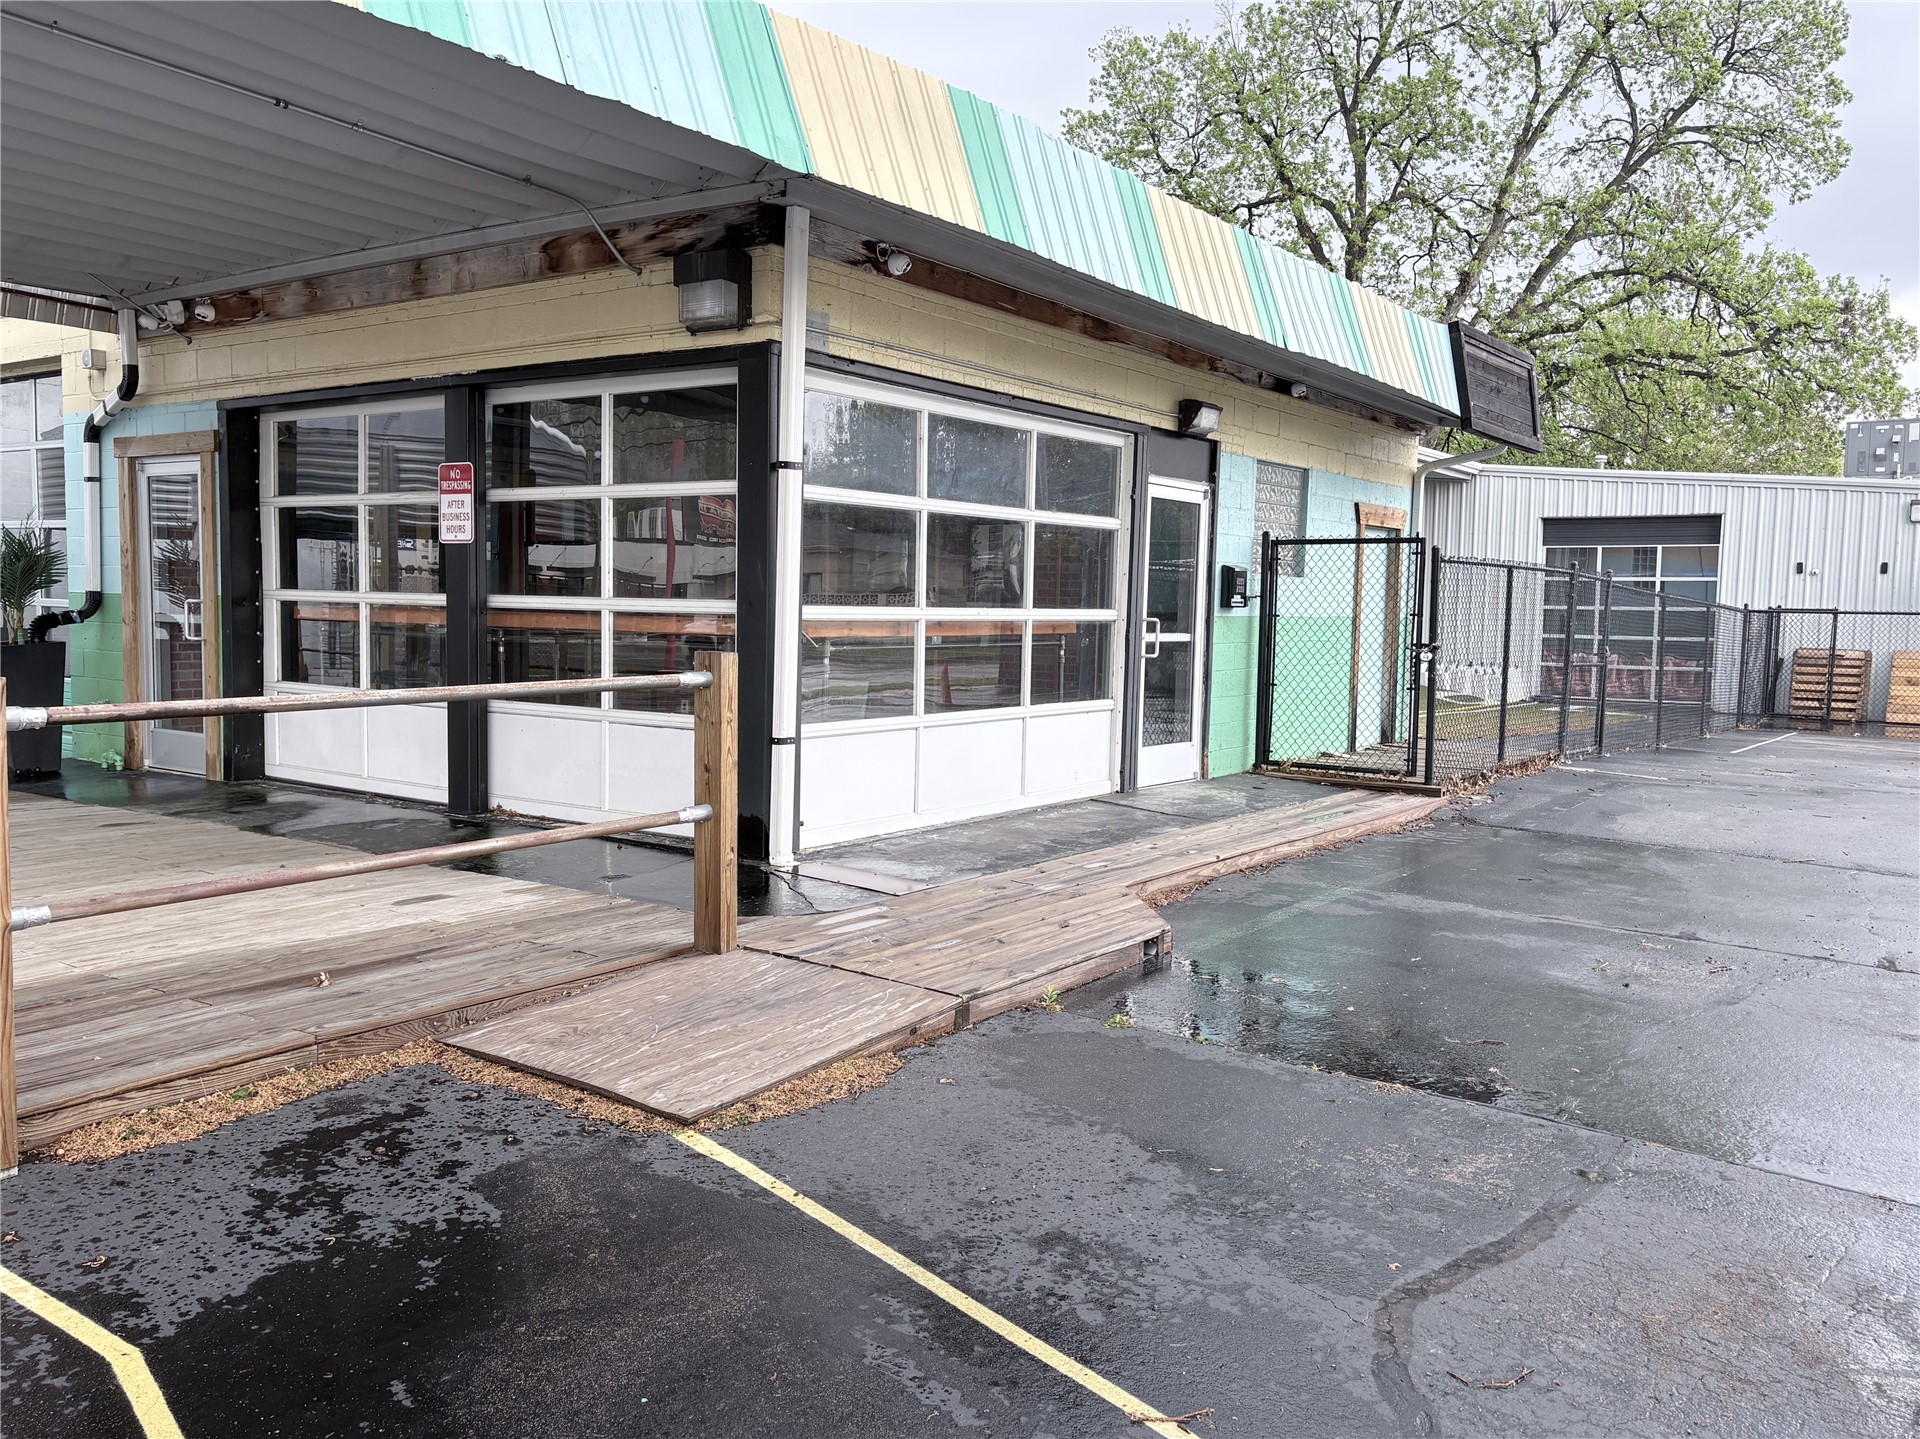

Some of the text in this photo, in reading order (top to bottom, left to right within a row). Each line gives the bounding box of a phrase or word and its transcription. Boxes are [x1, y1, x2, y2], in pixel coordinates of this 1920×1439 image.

[450, 469, 461, 479] NO
[441, 480, 471, 491] TRESPASSING
[447, 500, 465, 509] AFTER
[442, 512, 470, 521] BUSINESS
[446, 525, 466, 534] HOURS
